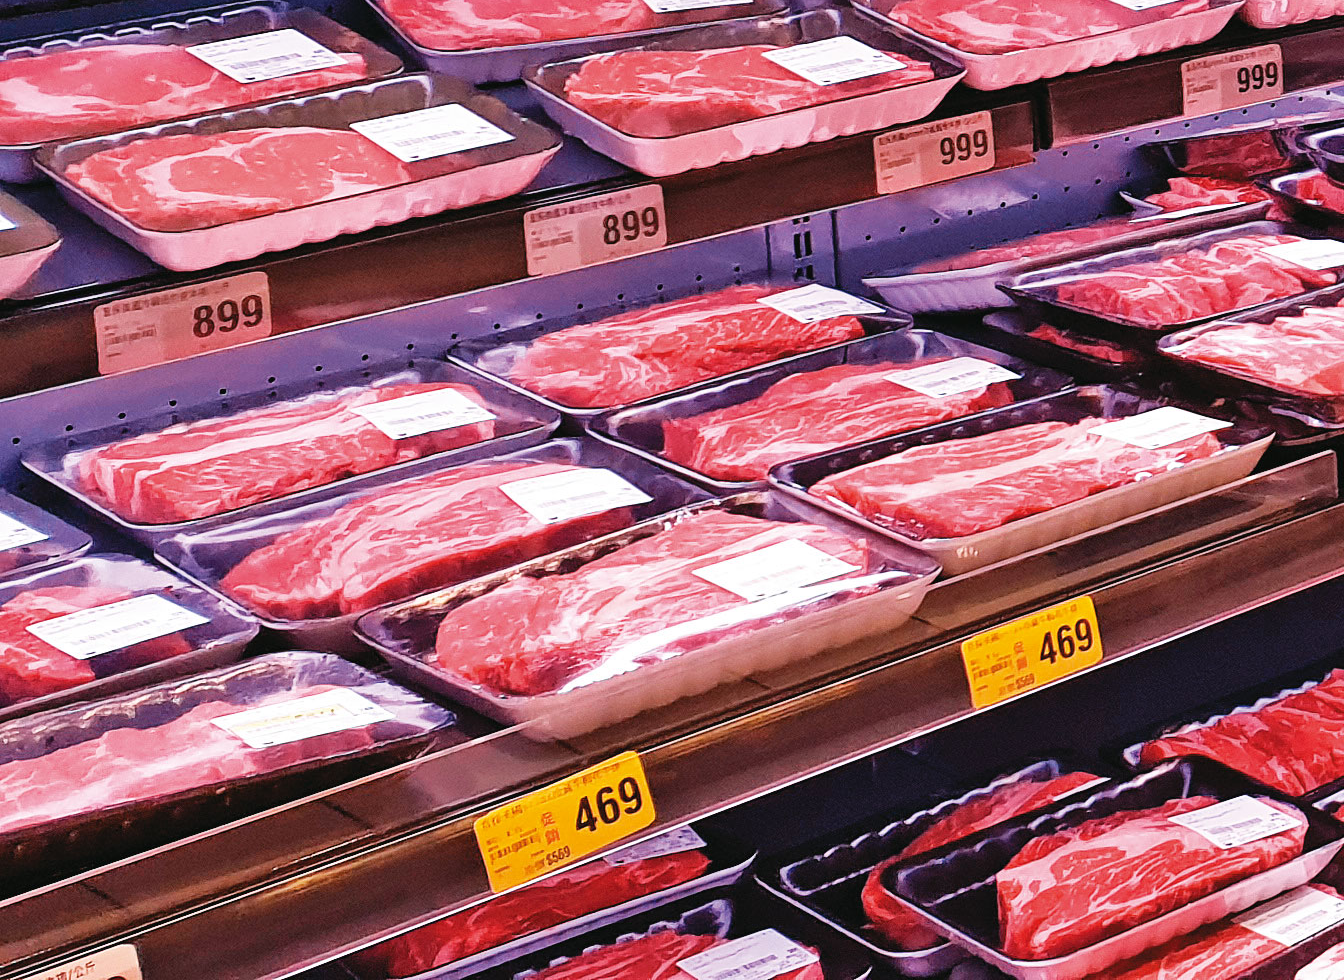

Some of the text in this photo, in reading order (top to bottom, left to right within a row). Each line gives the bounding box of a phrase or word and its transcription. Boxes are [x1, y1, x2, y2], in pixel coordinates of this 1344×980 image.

[1237, 61, 1278, 93] 999
[940, 129, 989, 165] 999
[603, 206, 660, 245] 899
[193, 294, 263, 338] 899
[1040, 618, 1093, 664] 469
[575, 776, 643, 832] 469
